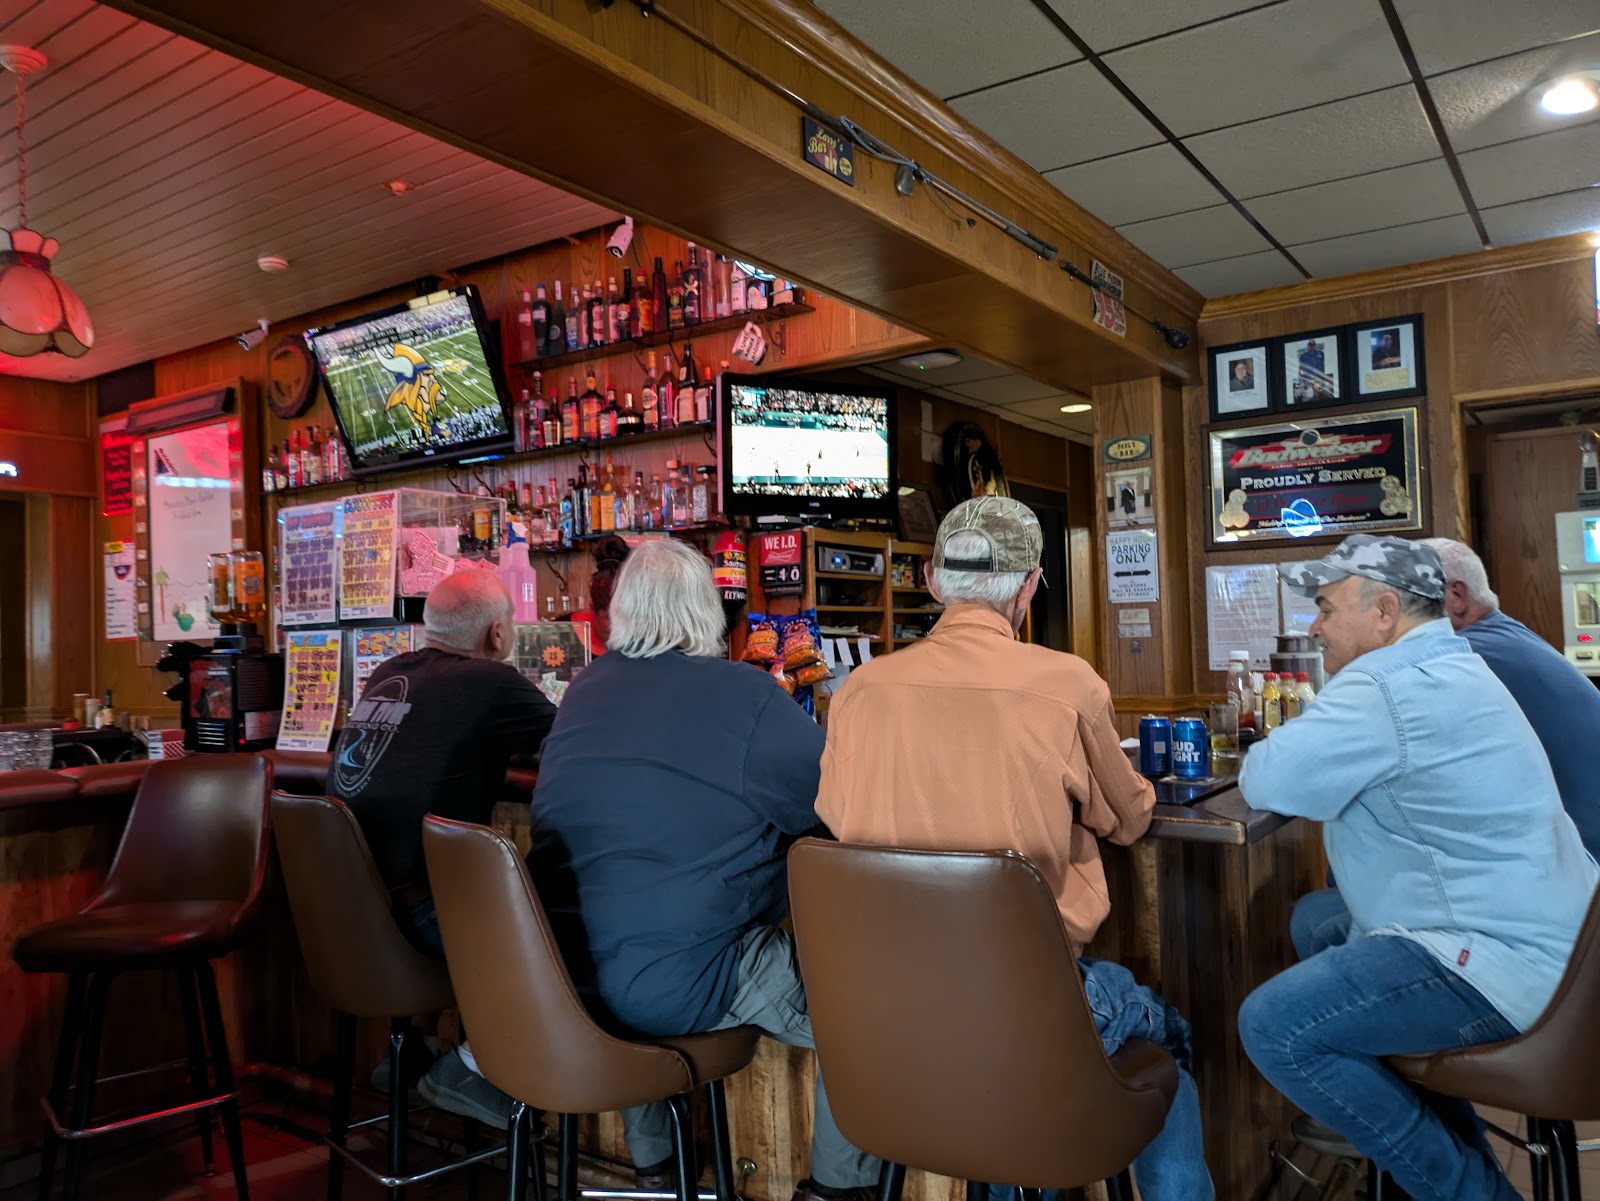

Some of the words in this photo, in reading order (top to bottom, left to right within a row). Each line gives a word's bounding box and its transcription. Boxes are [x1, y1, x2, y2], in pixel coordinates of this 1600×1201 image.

[808, 136, 827, 153] Bar
[1236, 435, 1383, 468] Budweiser
[1240, 473, 1315, 490] PROUDLY
[1317, 466, 1387, 482] SERVED
[764, 536, 780, 550] WE
[781, 535, 797, 549] I.D.
[1110, 536, 1131, 546] HAPPY
[1133, 535, 1153, 544] HOUR
[1112, 543, 1151, 555] PARKING
[1116, 553, 1147, 564] ONLY
[724, 590, 737, 600] KEY
[1171, 741, 1195, 752] BUD
